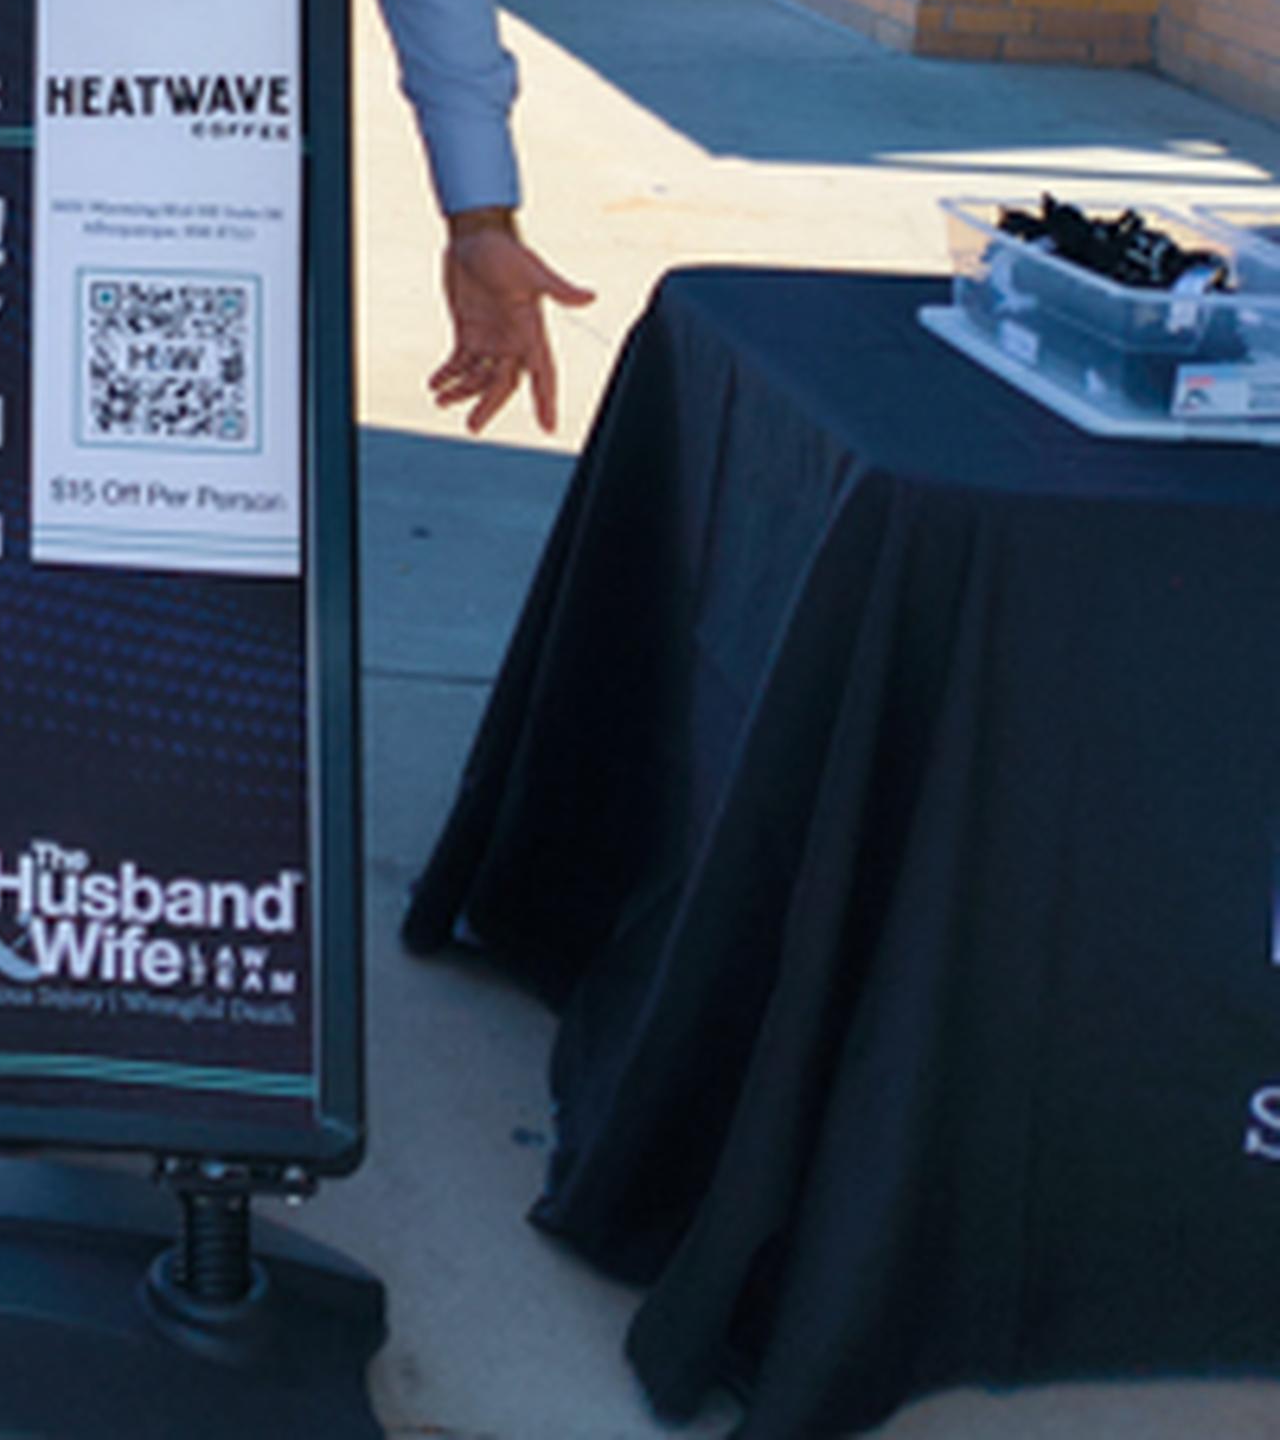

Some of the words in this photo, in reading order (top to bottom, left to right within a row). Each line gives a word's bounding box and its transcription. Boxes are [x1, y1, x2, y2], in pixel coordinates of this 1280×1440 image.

[45, 75, 289, 117] HEATWAVE
[191, 121, 289, 140] COFFEE
[50, 476, 97, 506] $15
[101, 478, 140, 507] Off
[147, 481, 189, 508] Per
[196, 484, 288, 513] Person
[31, 838, 89, 871] The
[27, 918, 183, 985] Wife
